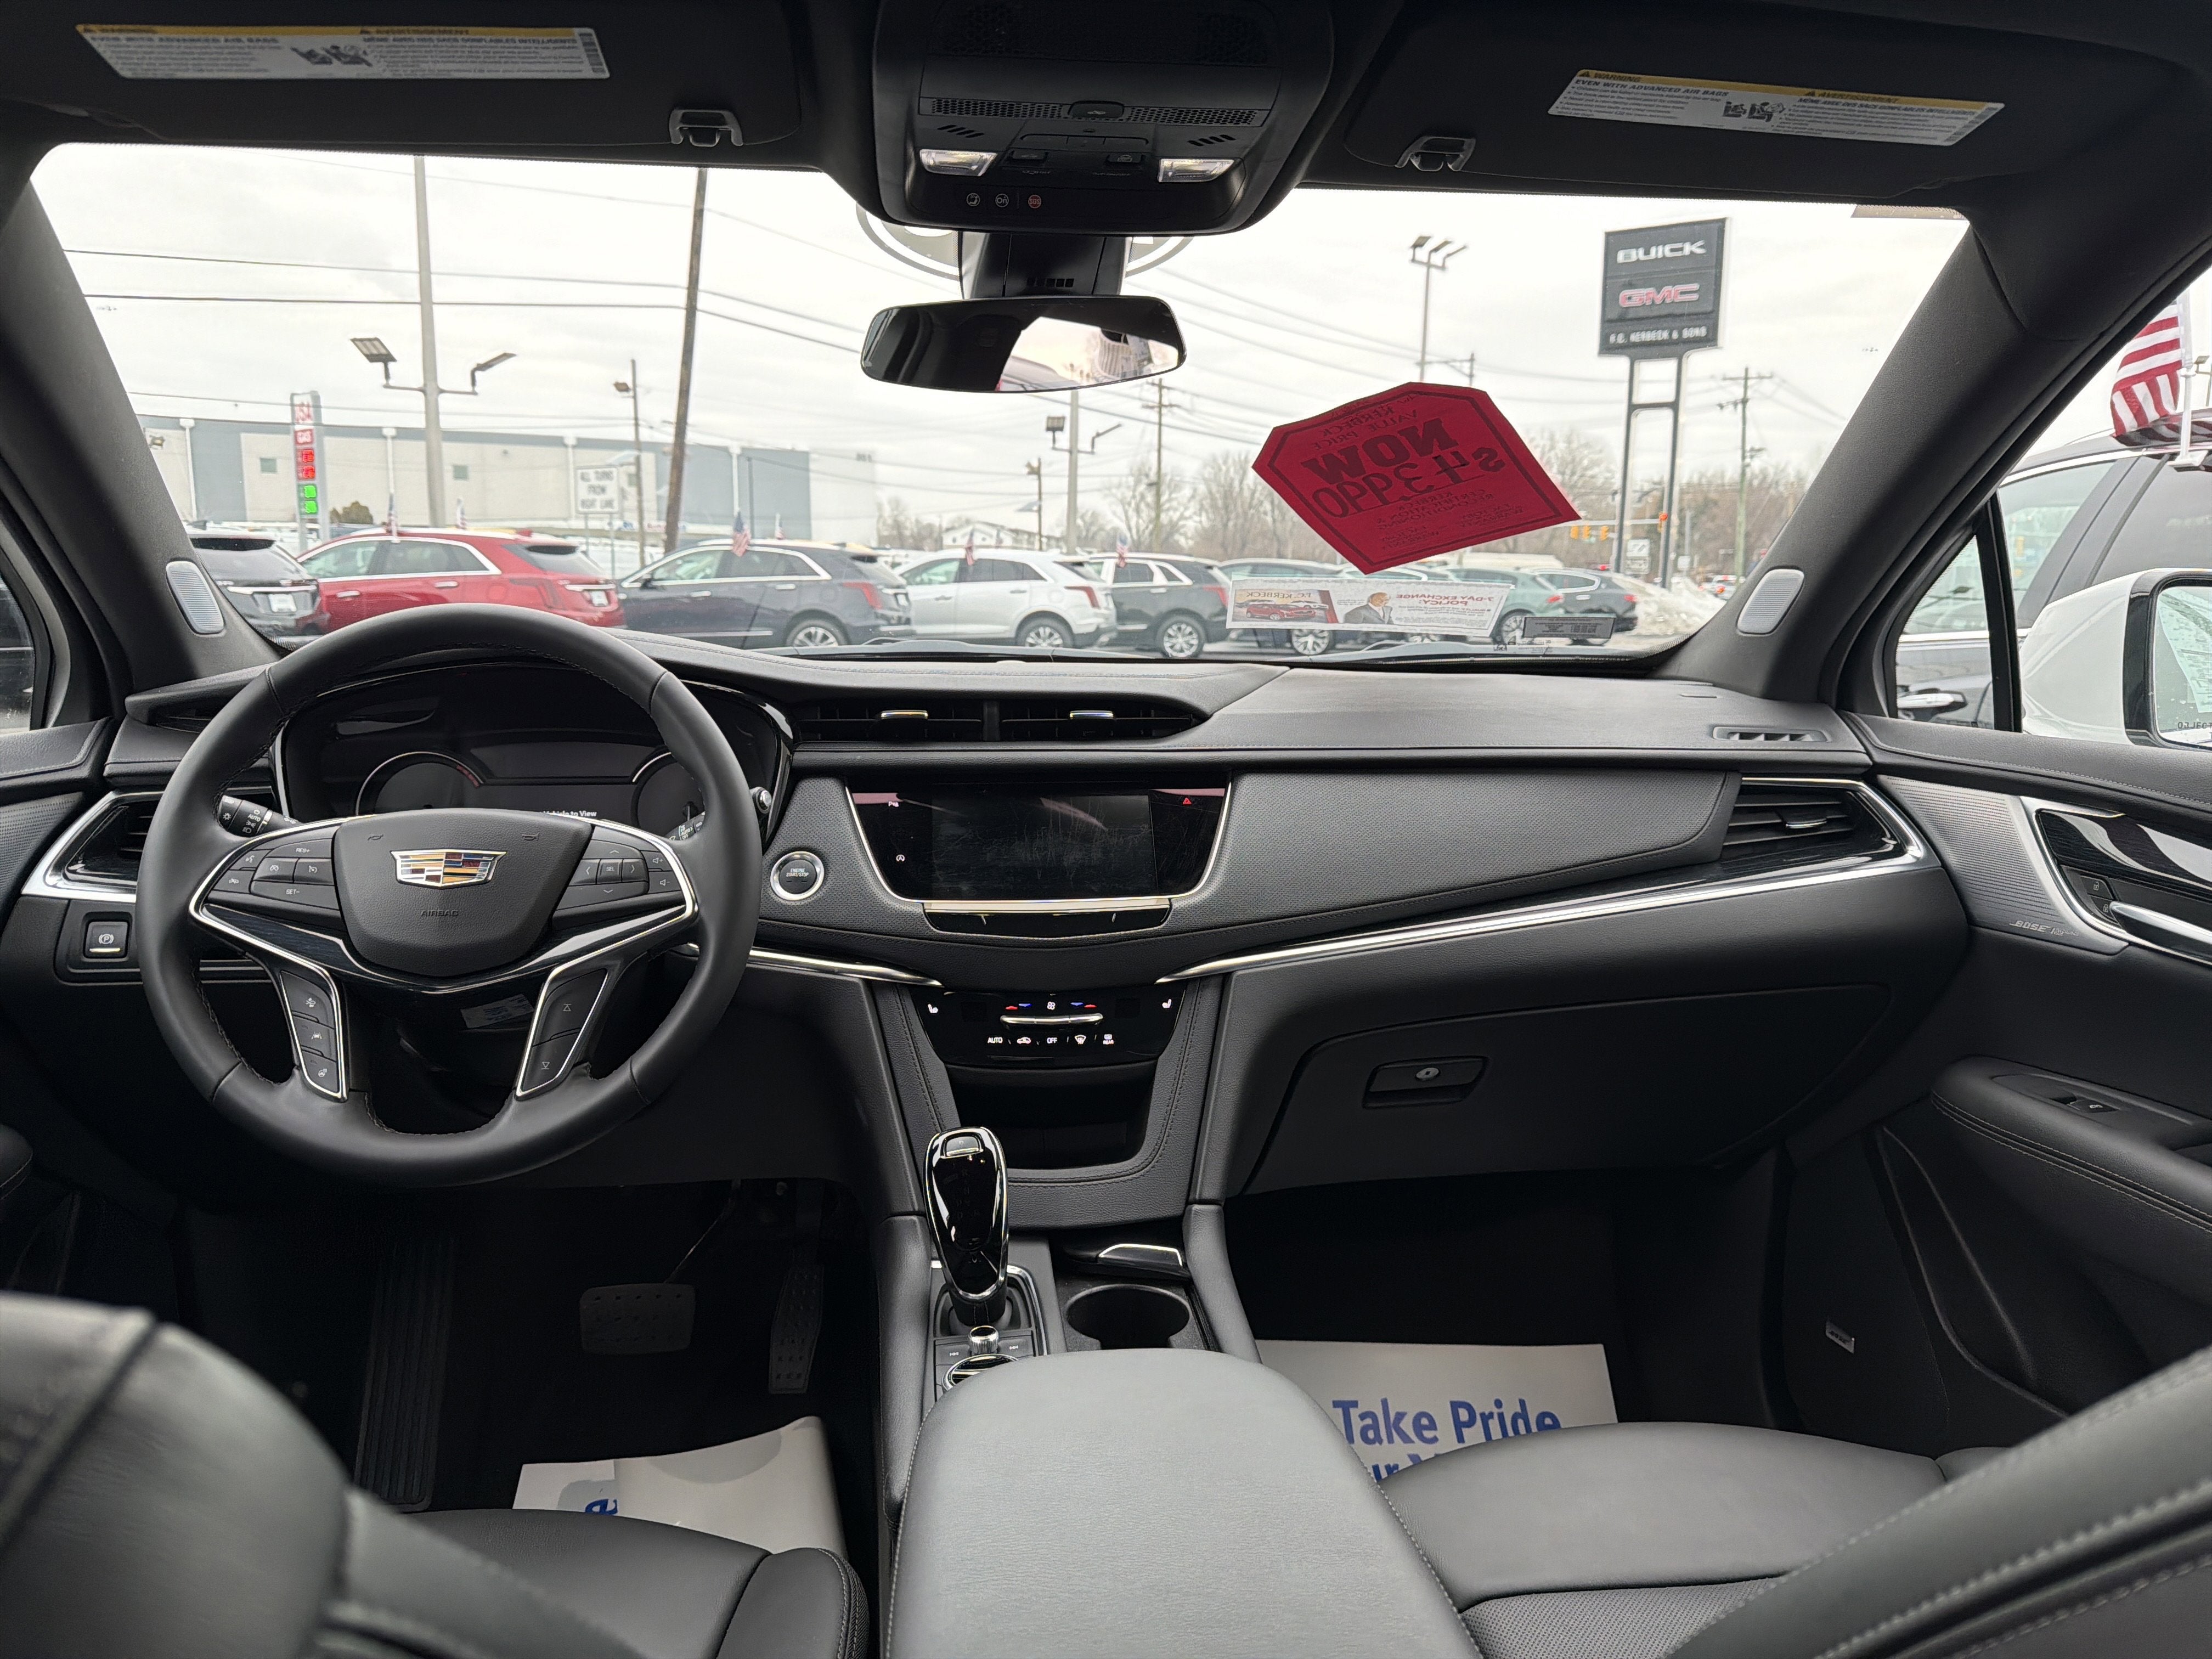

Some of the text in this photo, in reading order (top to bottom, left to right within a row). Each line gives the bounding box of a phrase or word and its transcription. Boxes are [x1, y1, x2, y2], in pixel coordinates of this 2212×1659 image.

[1628, 84, 1681, 93] ADVANCED
[1617, 240, 1707, 263] BUICK
[1619, 283, 1700, 308] GMC
[247, 813, 261, 822] AUTO
[2009, 920, 2050, 933] BOSE
[1331, 1398, 1562, 1445] Take Pride
